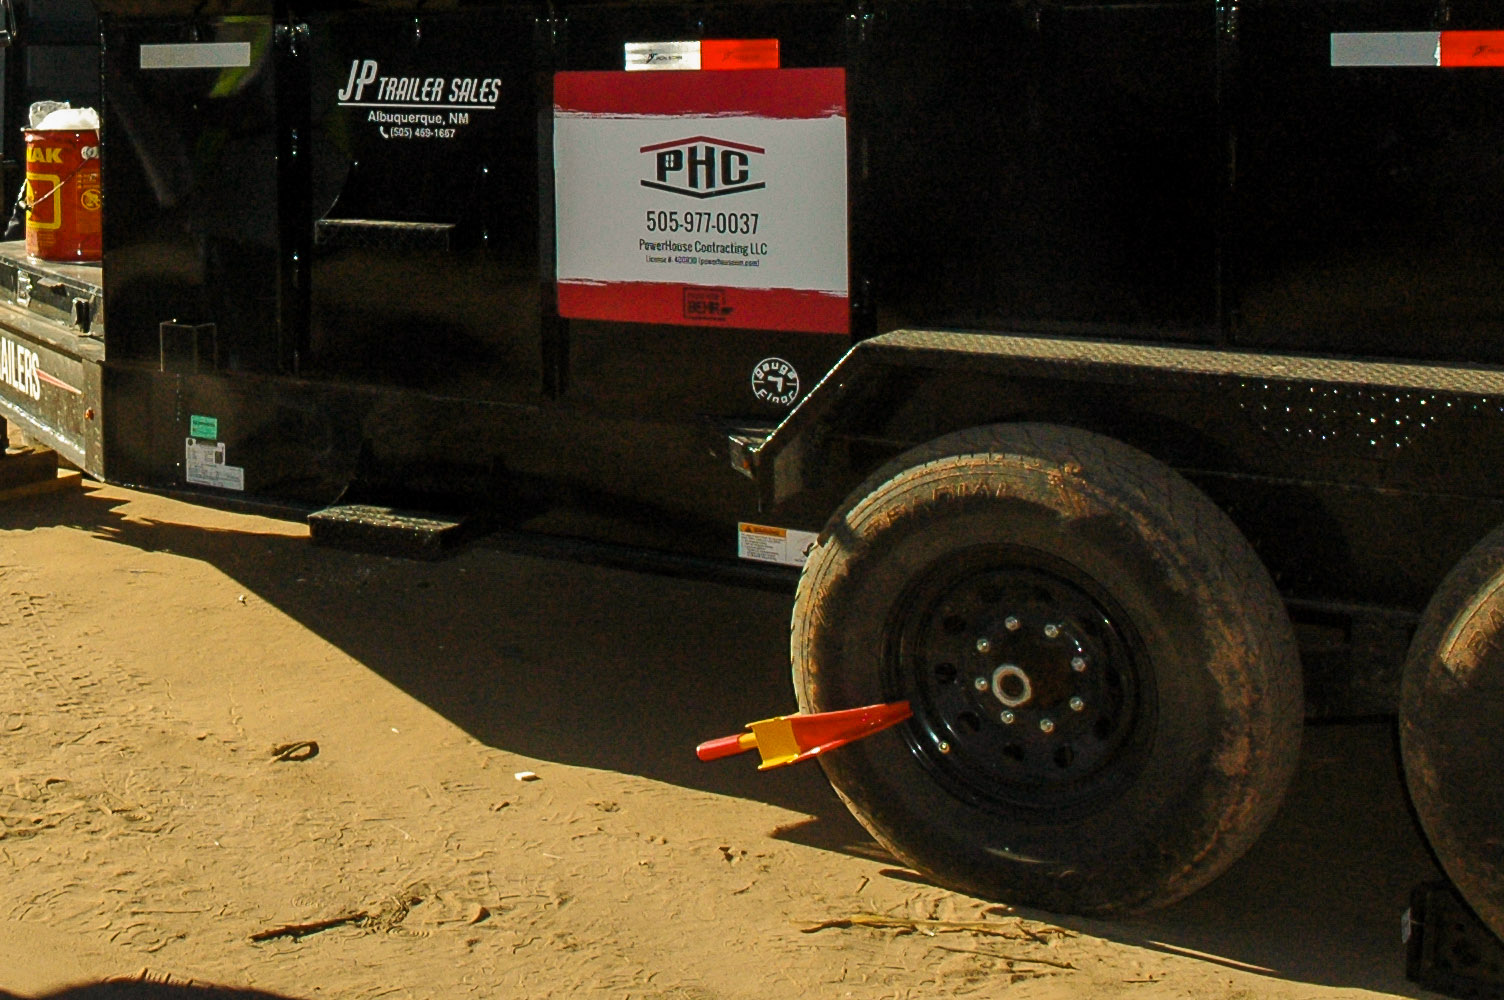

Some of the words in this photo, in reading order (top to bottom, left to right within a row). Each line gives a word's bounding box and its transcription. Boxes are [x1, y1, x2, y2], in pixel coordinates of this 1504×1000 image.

[338, 59, 378, 101] JP
[378, 77, 445, 102] TRAILER
[449, 78, 502, 103] SALES
[367, 110, 446, 126] Albuquerque,
[449, 112, 469, 124] NM
[656, 145, 749, 189] PHC
[647, 211, 759, 234] 505-977-0037
[639, 239, 693, 253] PowerHouse
[694, 241, 749, 257] Contracting
[750, 243, 768, 255] LLC
